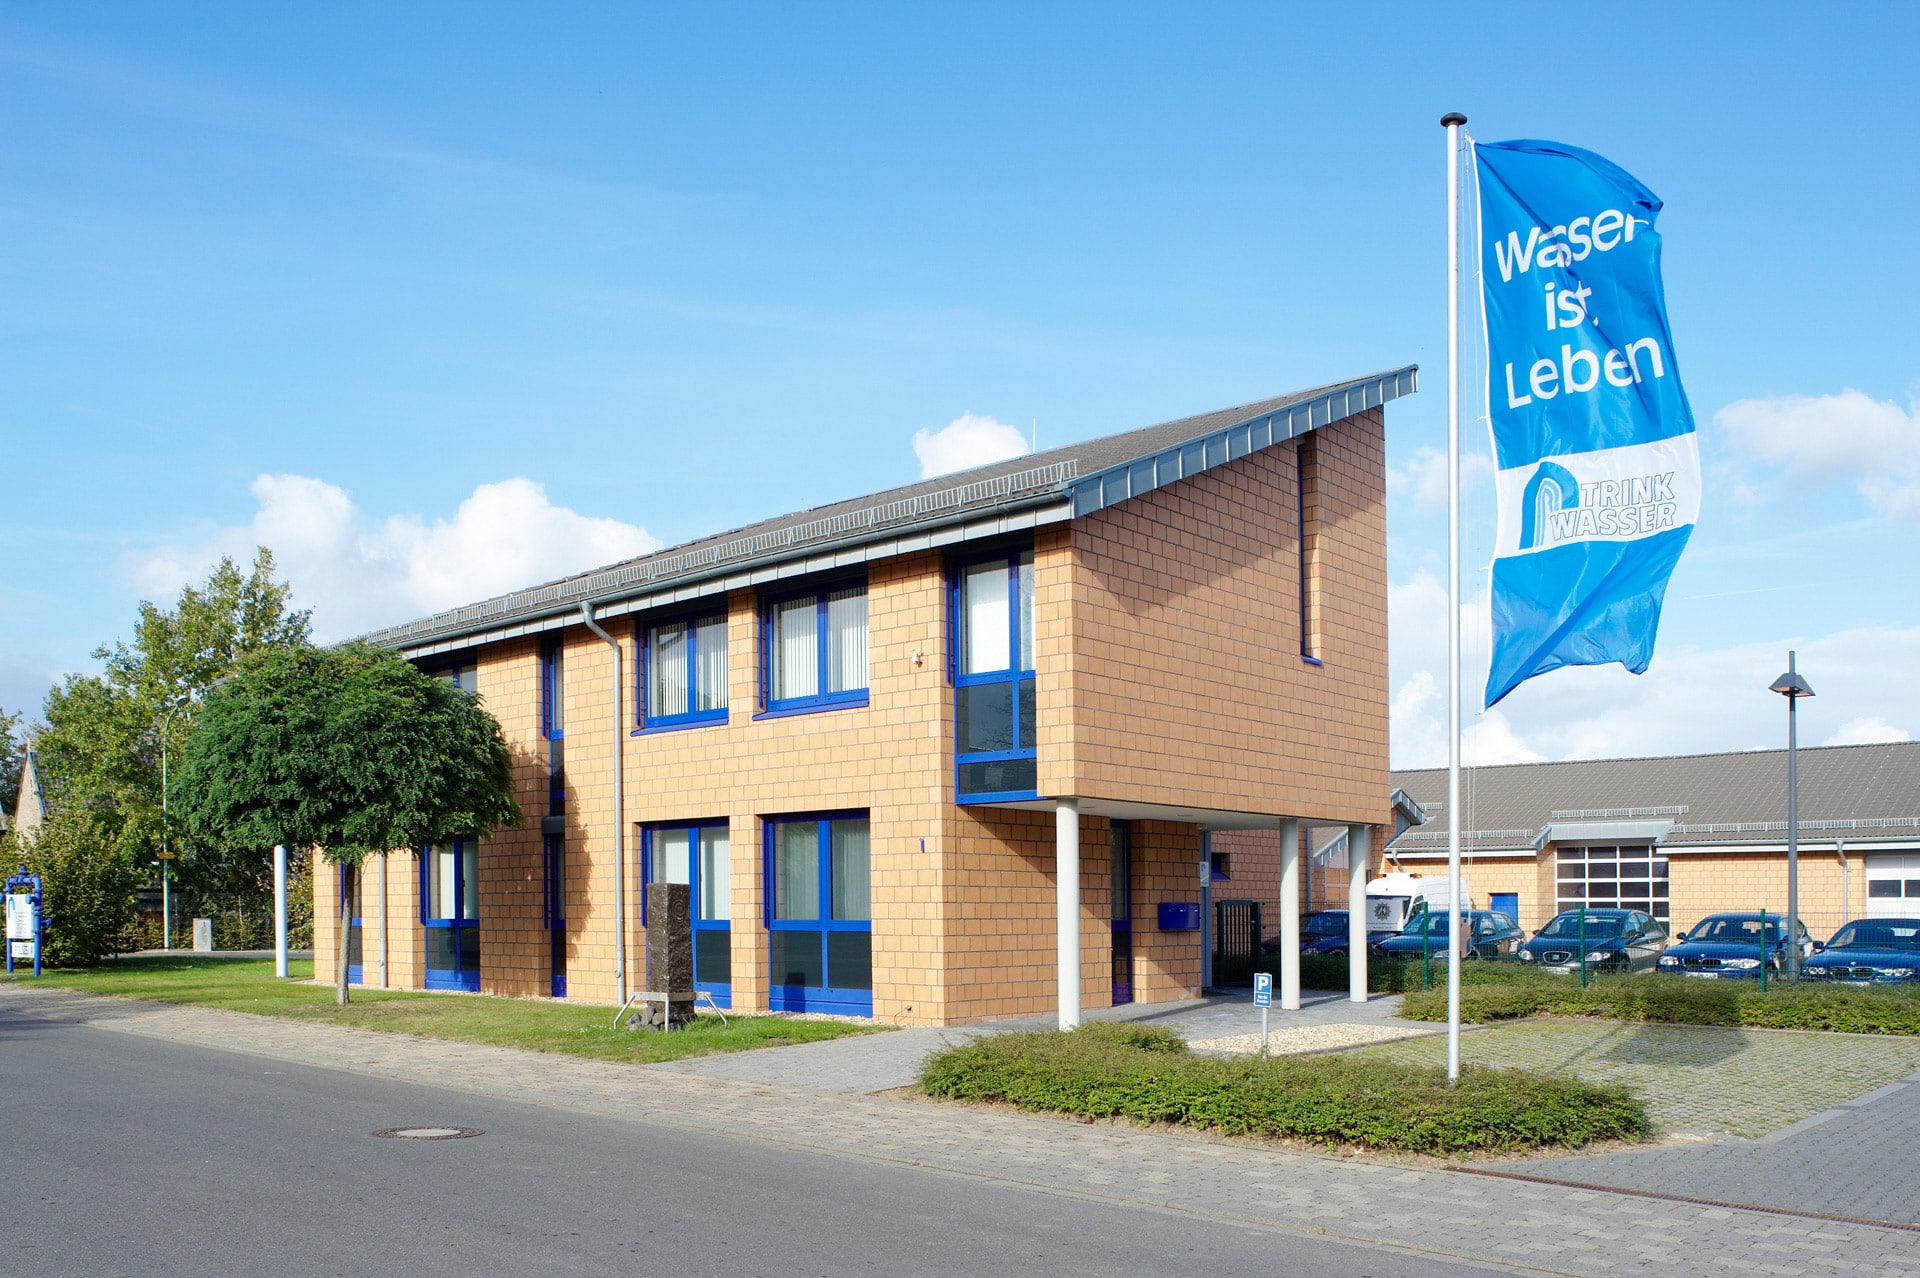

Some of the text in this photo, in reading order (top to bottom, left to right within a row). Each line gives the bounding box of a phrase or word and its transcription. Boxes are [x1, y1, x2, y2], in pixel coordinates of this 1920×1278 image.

[1495, 209, 1650, 283] Wasser
[1544, 280, 1599, 331] ist
[1505, 336, 1665, 409] Leben
[1580, 471, 1675, 508] TRINK
[1550, 502, 1677, 541] WASSER
[1258, 976, 1269, 991] P
